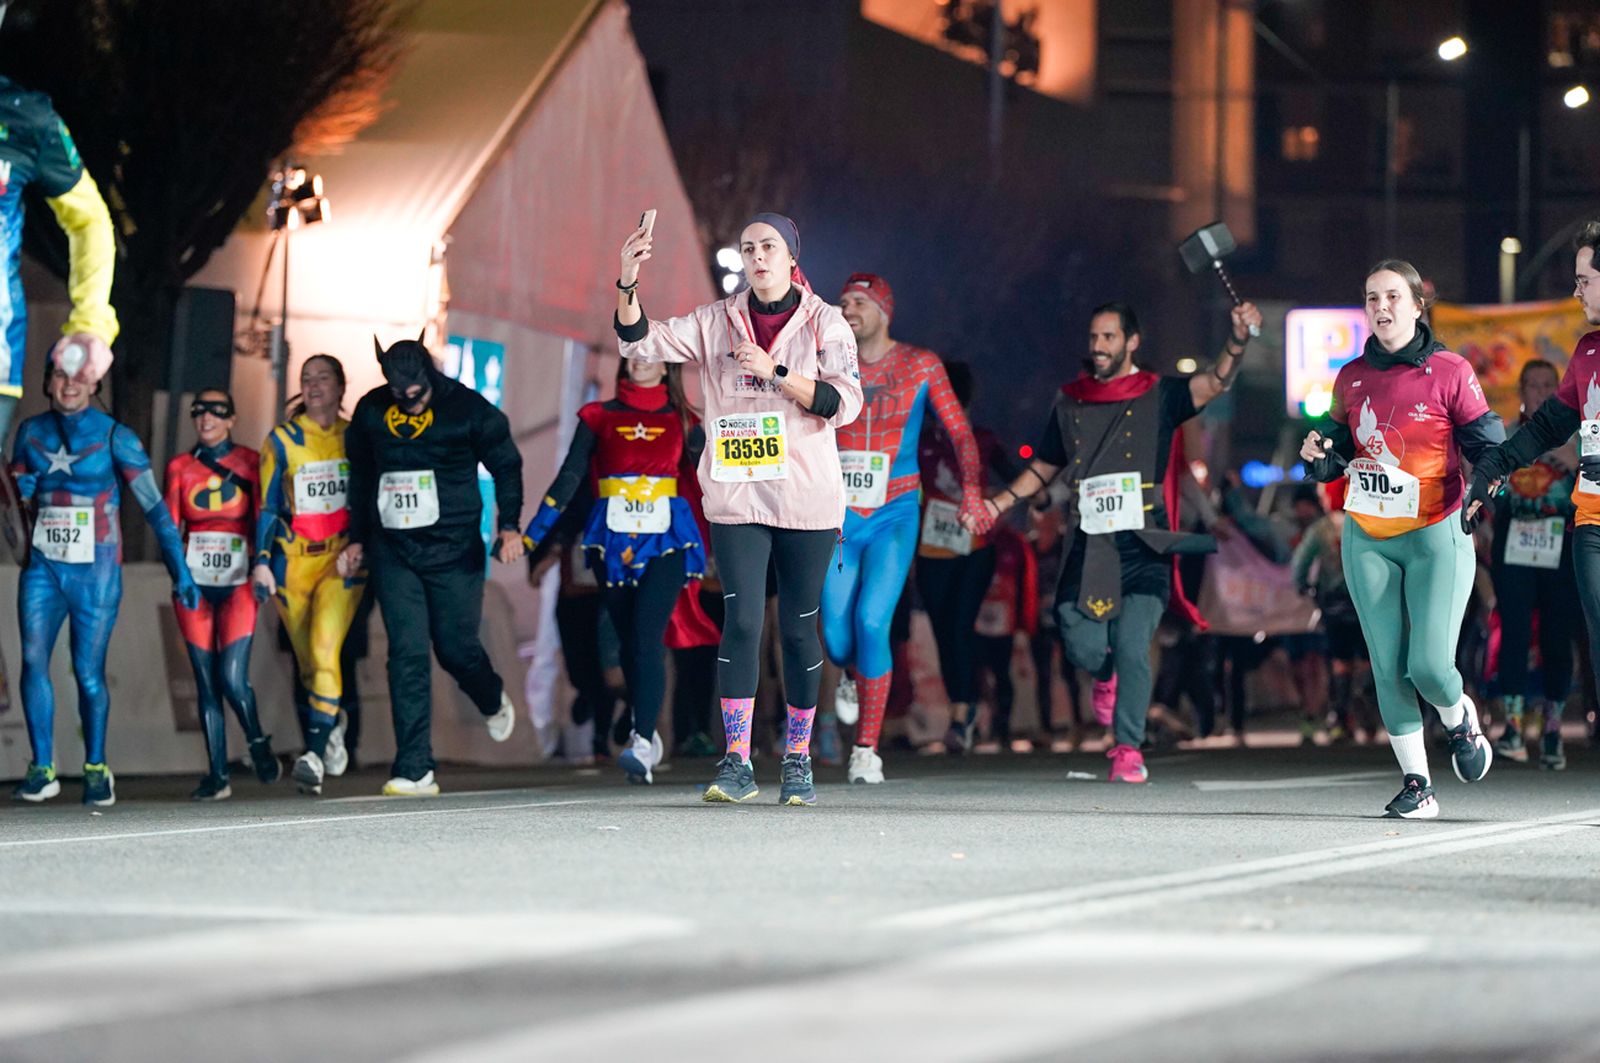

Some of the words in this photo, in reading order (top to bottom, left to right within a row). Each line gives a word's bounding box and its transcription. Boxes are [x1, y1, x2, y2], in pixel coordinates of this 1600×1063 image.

[721, 437, 779, 460] 13536
[1366, 435, 1384, 455] 43
[307, 480, 346, 497] 6204
[394, 493, 418, 509] 311
[1095, 496, 1123, 513] 307
[46, 528, 81, 543] 1632
[202, 552, 232, 568] 309
